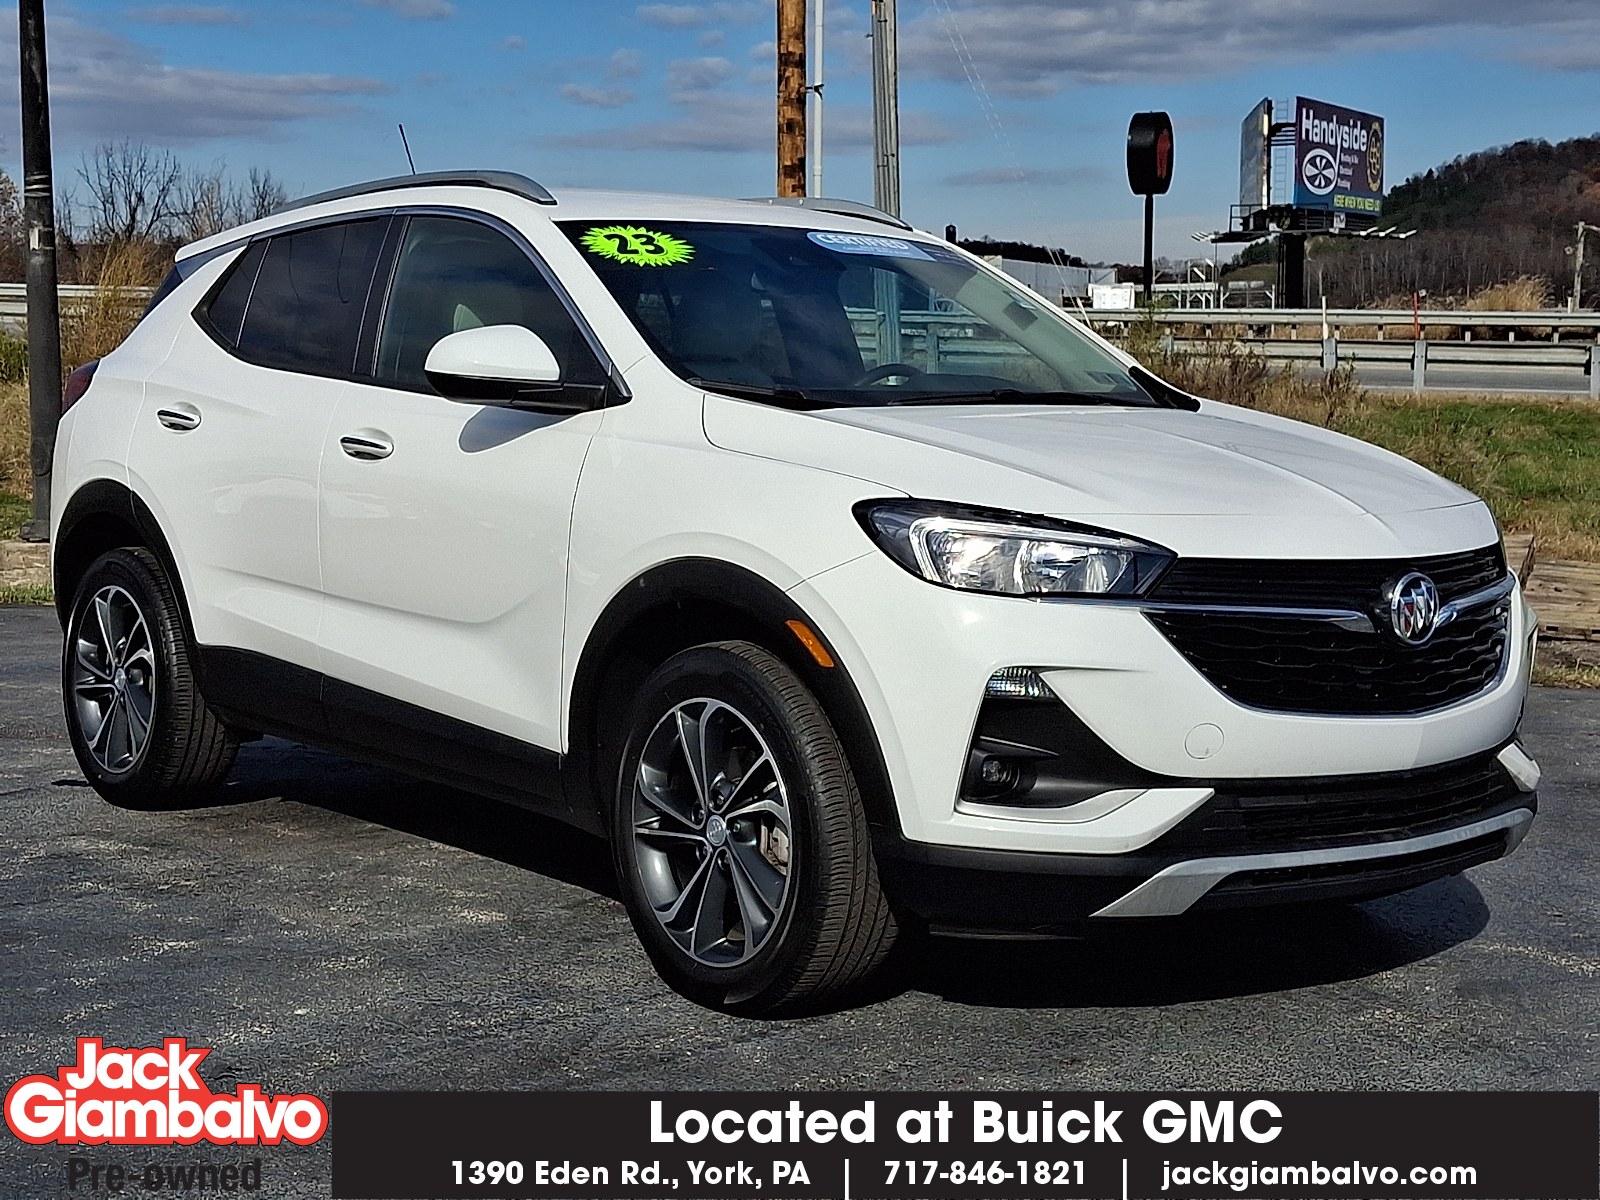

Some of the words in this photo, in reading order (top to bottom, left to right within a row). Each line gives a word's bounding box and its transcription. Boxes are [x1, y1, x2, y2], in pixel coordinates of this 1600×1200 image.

[1302, 107, 1367, 152] Handyside
[602, 233, 665, 255] 23
[816, 233, 909, 250] CERTIFIED
